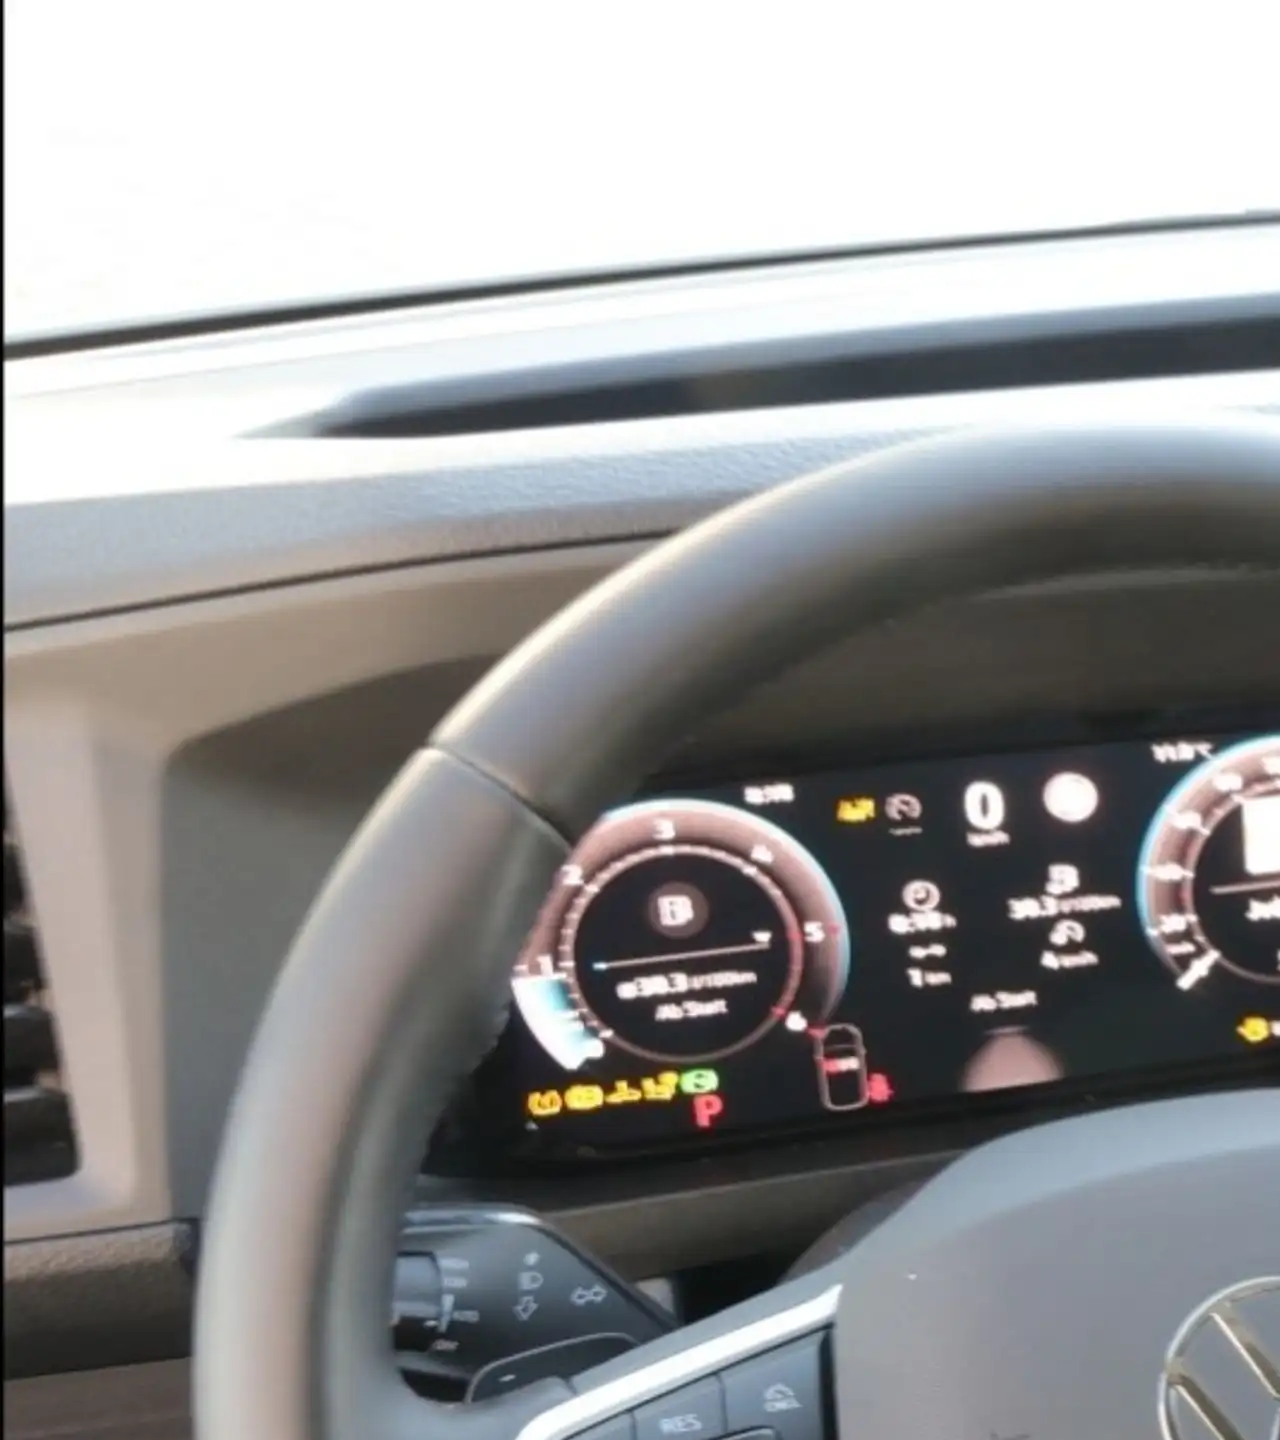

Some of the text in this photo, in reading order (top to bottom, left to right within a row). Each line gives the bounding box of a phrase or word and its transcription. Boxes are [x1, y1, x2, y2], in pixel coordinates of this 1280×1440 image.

[964, 779, 1006, 831] 0
[694, 1095, 722, 1127] P
[658, 1412, 703, 1435] RES
